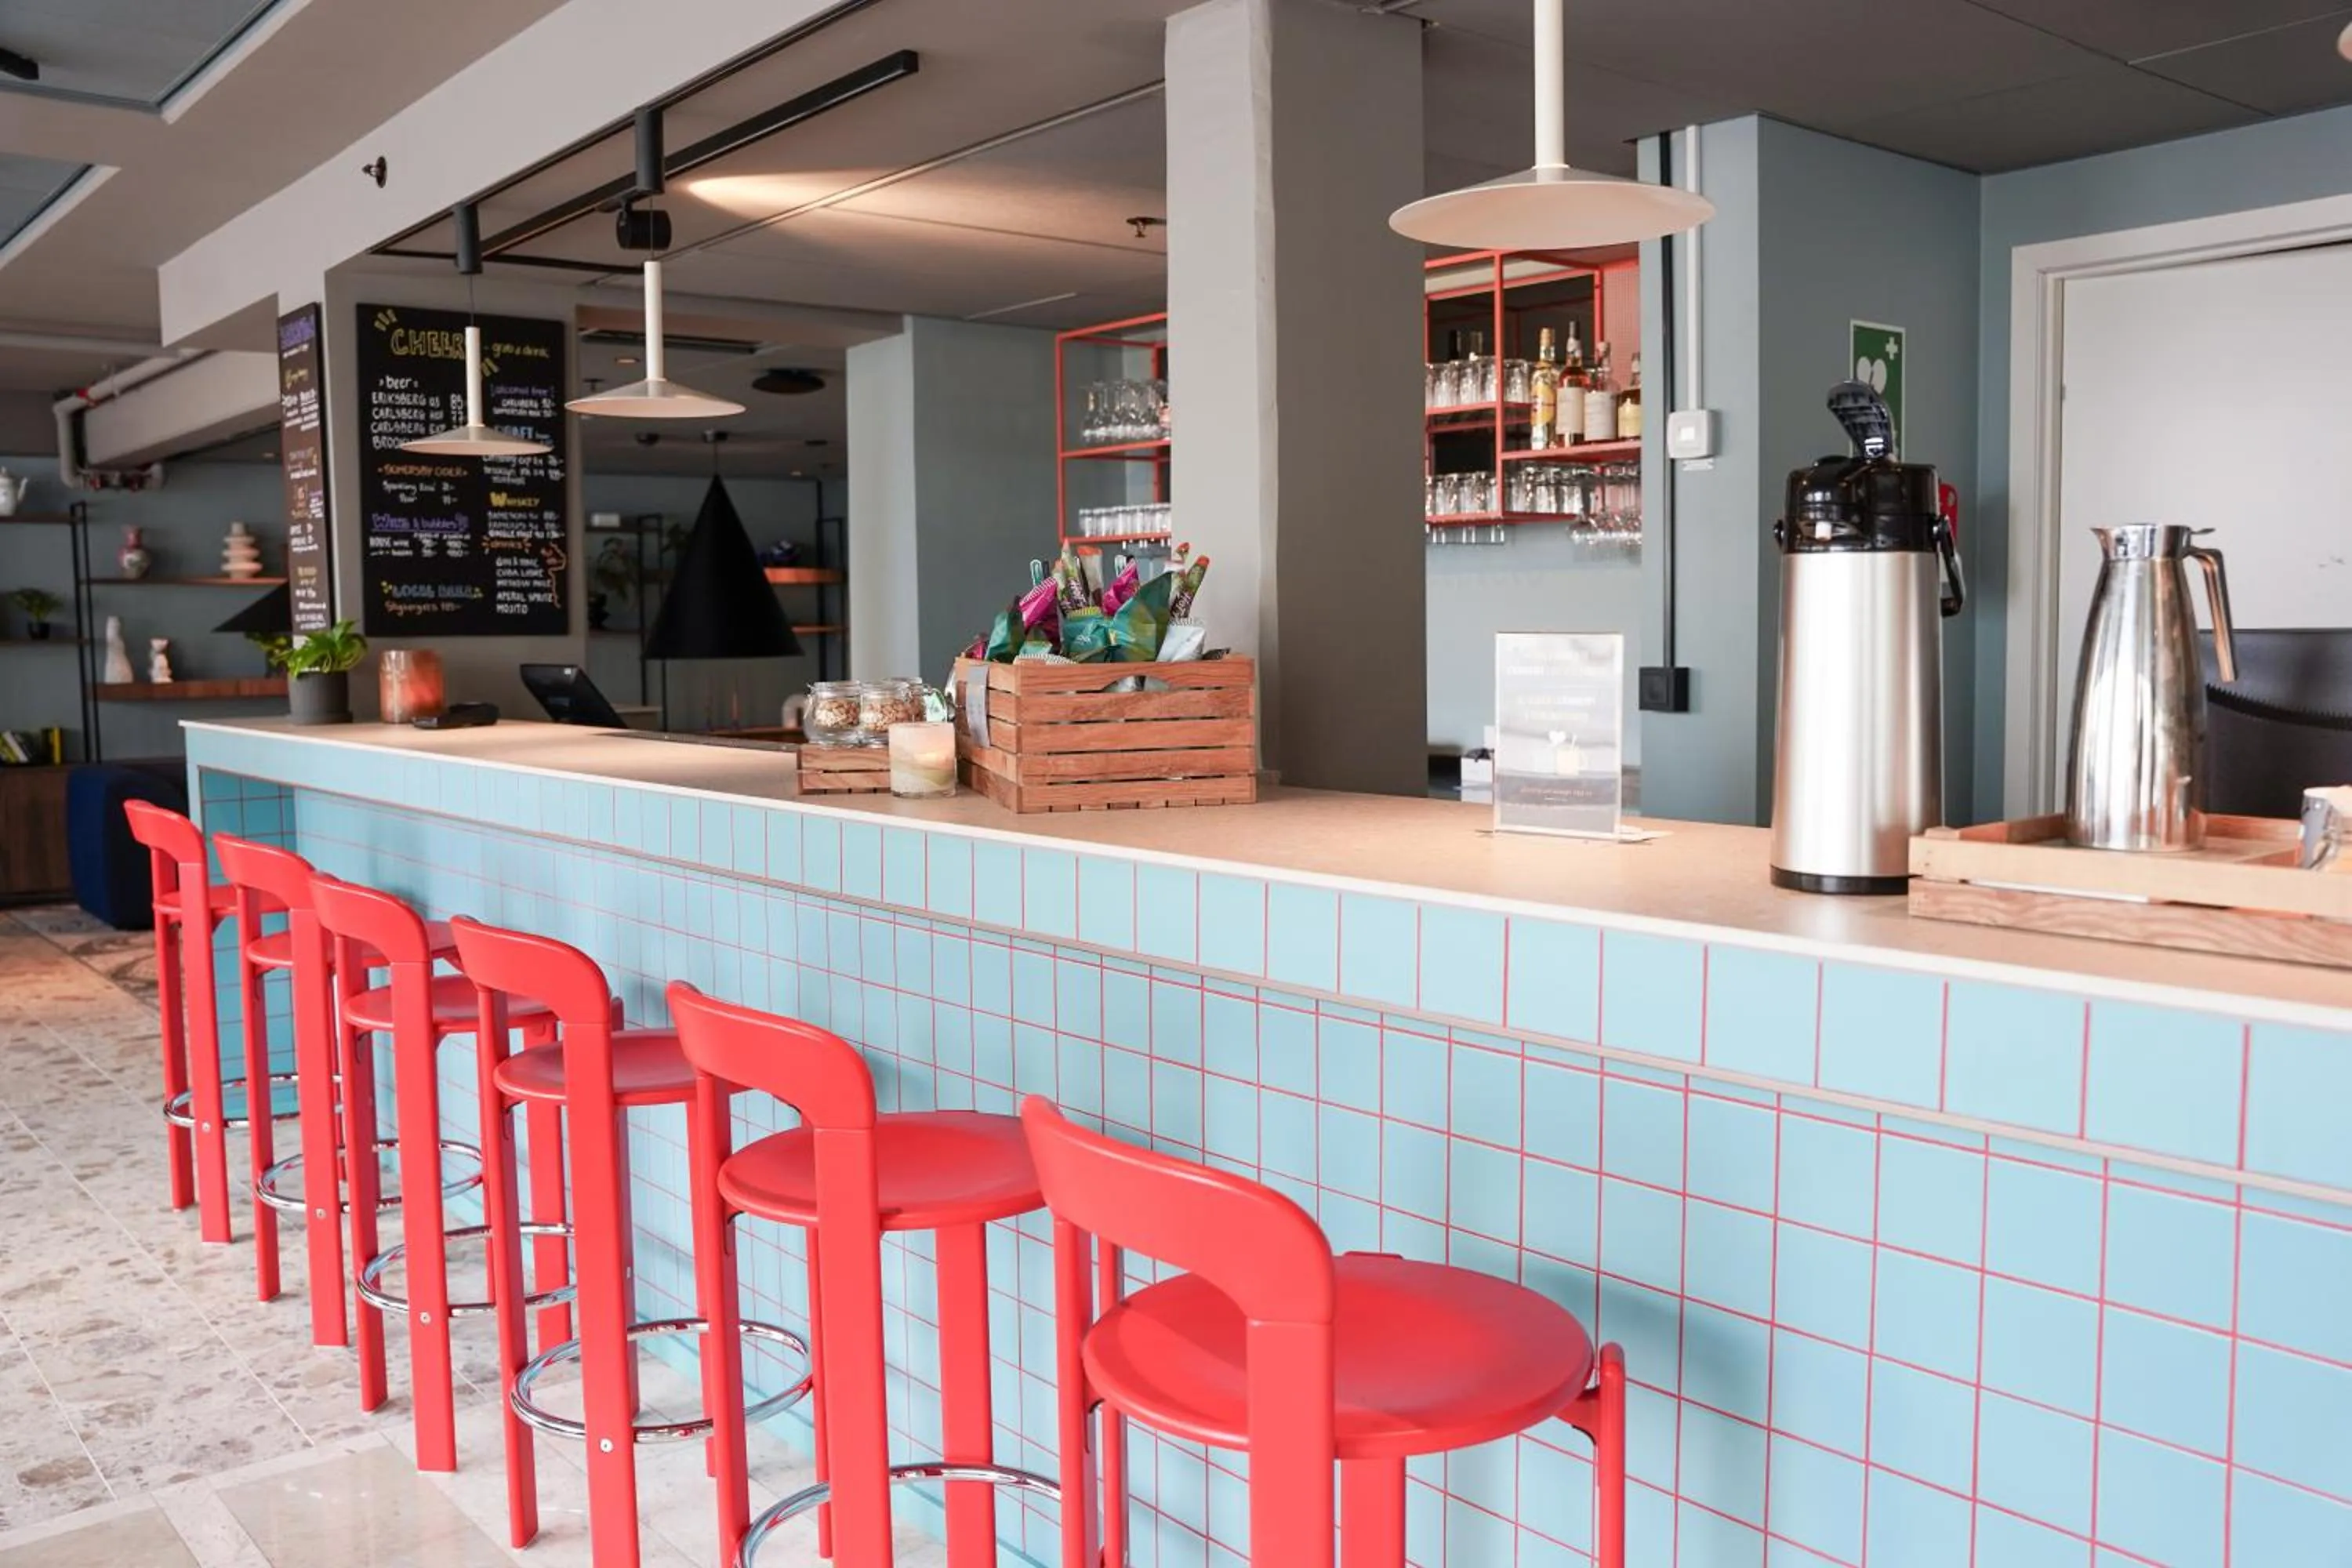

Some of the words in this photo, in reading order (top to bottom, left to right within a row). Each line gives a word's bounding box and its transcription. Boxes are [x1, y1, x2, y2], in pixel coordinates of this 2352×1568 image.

[391, 328, 466, 360] CHEER
[386, 375, 412, 390] beer
[372, 407, 426, 421] CARLSBERG
[370, 422, 426, 434] CARLSBERG
[496, 603, 528, 615] MOJITO
